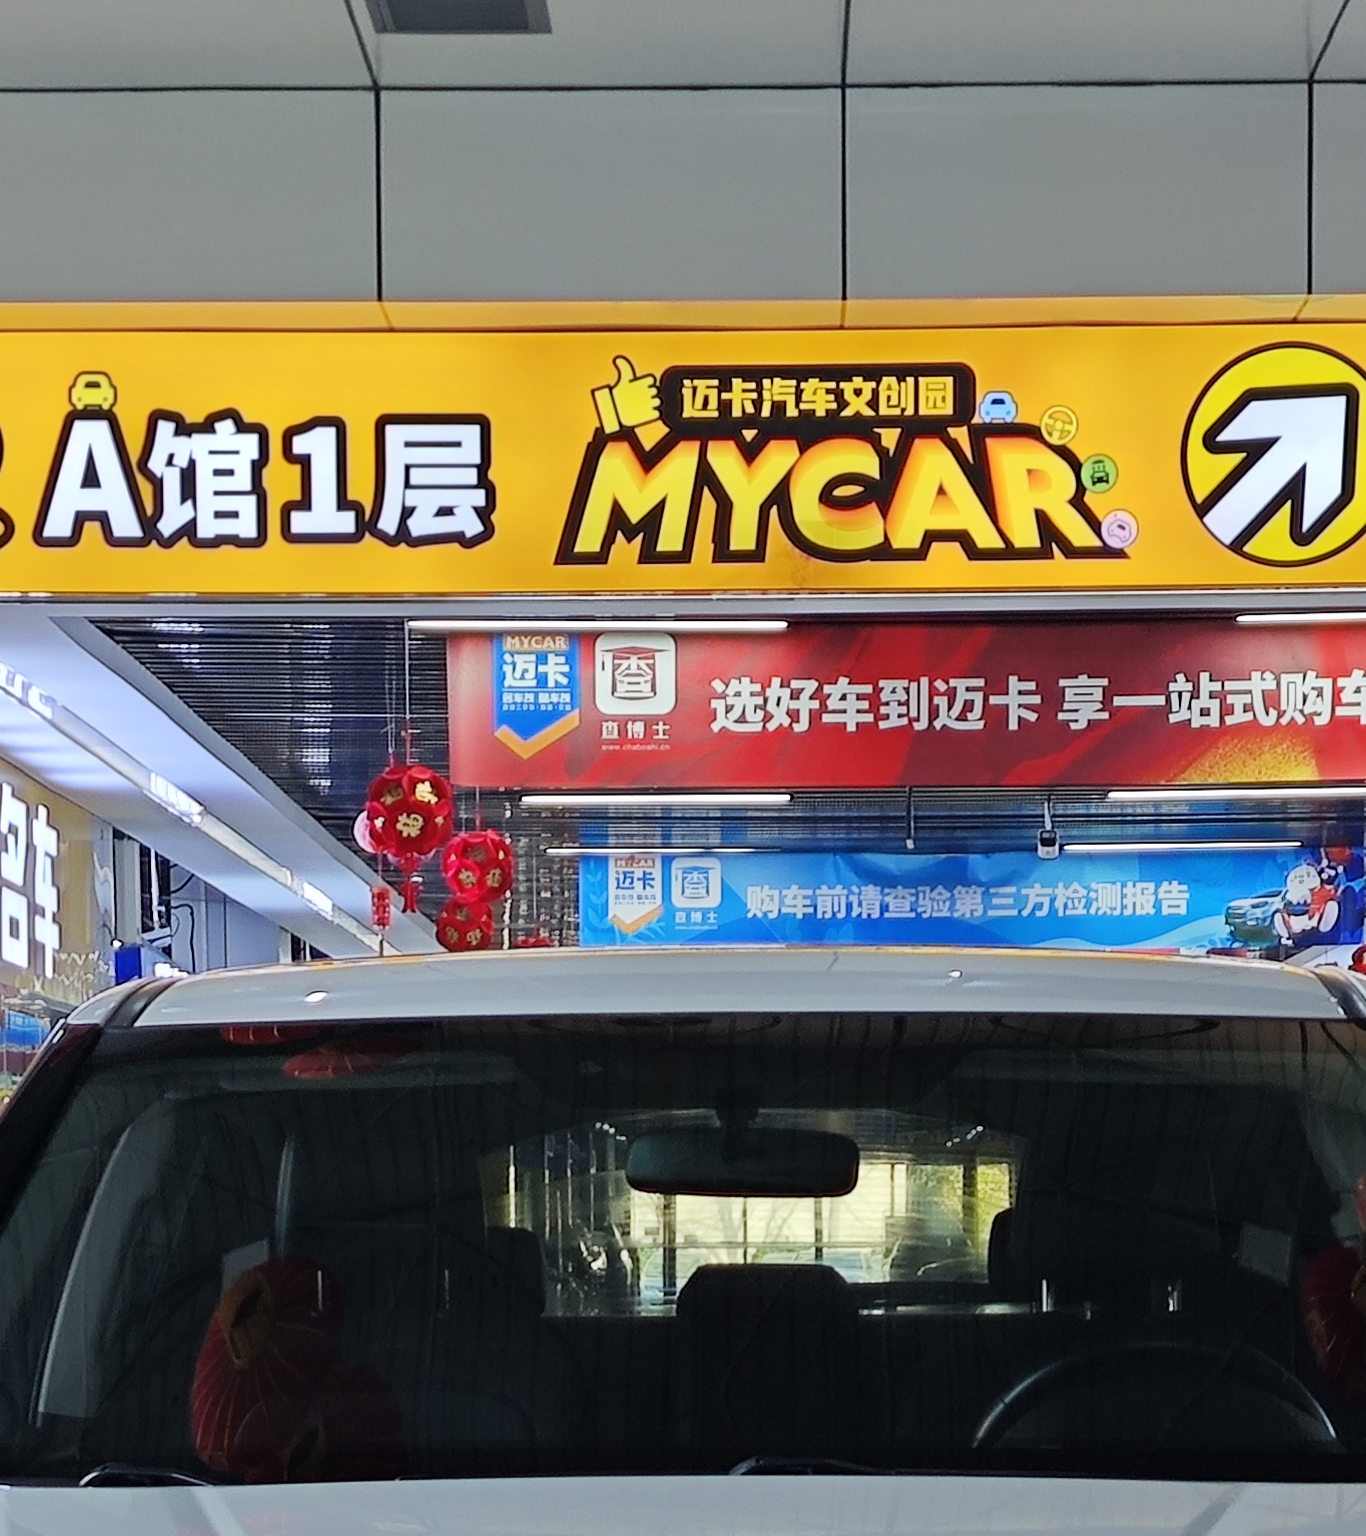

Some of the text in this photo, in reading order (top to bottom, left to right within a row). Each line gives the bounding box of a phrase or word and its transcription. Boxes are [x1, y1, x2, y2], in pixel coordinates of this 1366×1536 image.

[681, 376, 955, 420] 迈卡汽车文创园
[560, 430, 1119, 562] MYCAR
[505, 635, 568, 650] MYCAR
[502, 652, 571, 688] 迈卡
[709, 673, 1042, 734] 选好车到迈卡
[601, 720, 671, 740] 查博士
[614, 870, 656, 890] 迈卡
[746, 881, 1190, 920] 购车前请查验第三方检测报告
